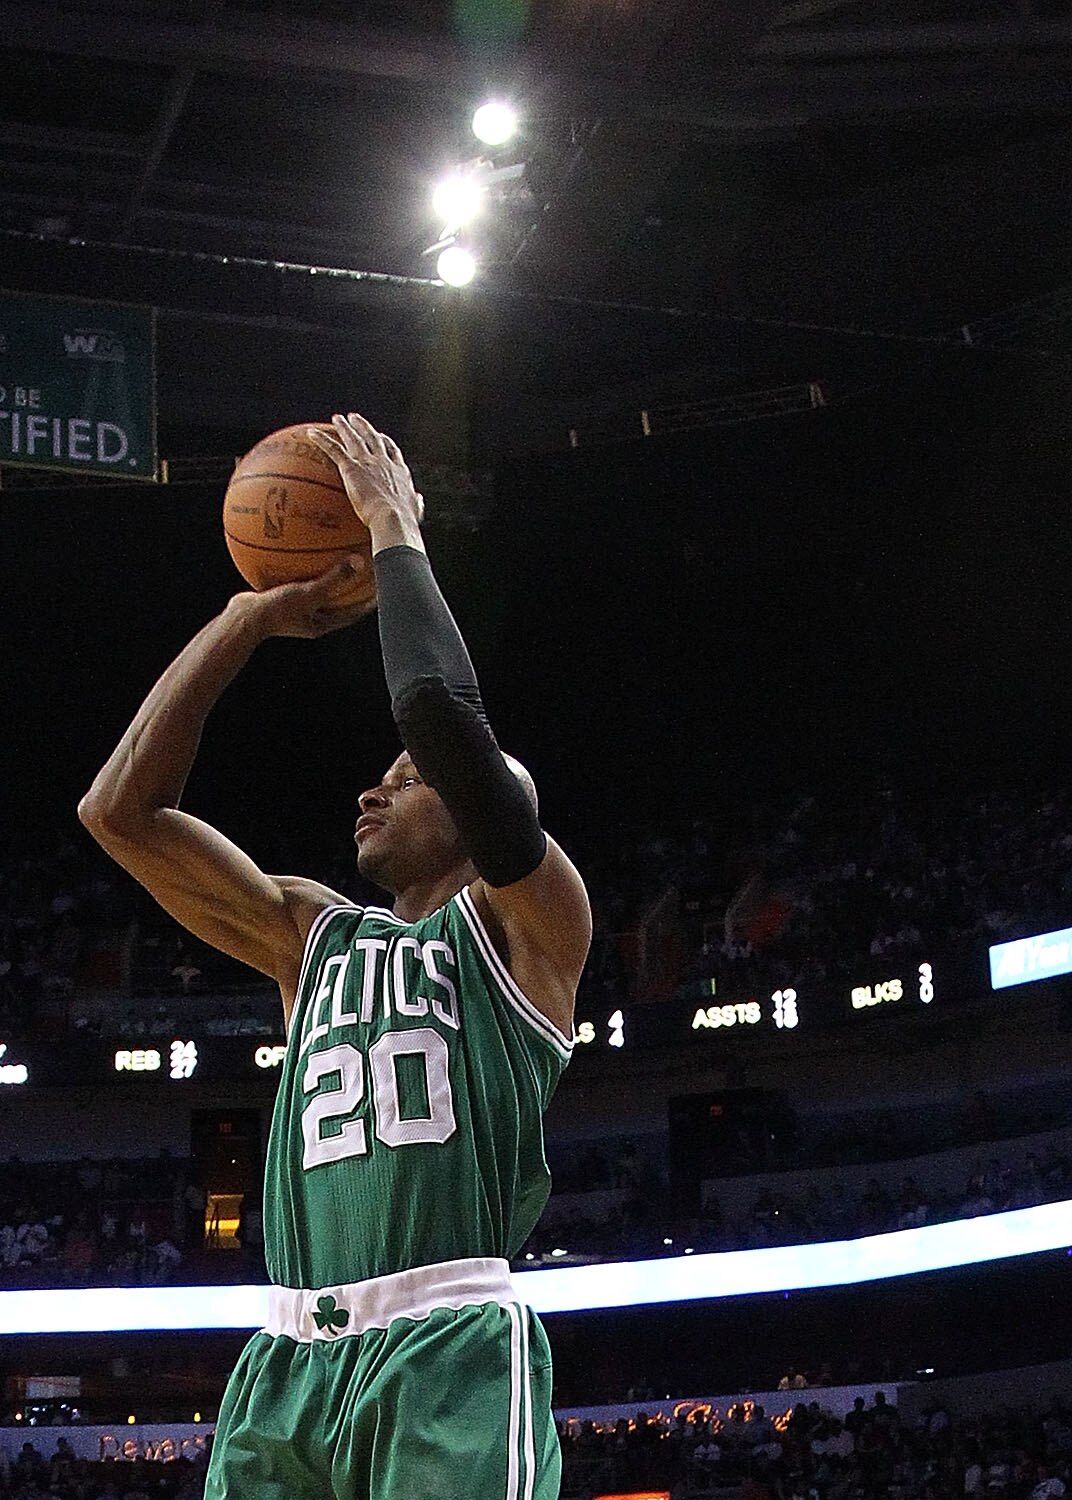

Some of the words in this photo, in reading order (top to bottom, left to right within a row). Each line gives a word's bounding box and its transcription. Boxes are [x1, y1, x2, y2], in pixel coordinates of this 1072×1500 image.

[14, 386, 41, 408] BE
[851, 978, 904, 1010] BLKS
[691, 1001, 762, 1030] ASSTS
[114, 1048, 161, 1072] REB
[302, 1027, 458, 1172] 20
